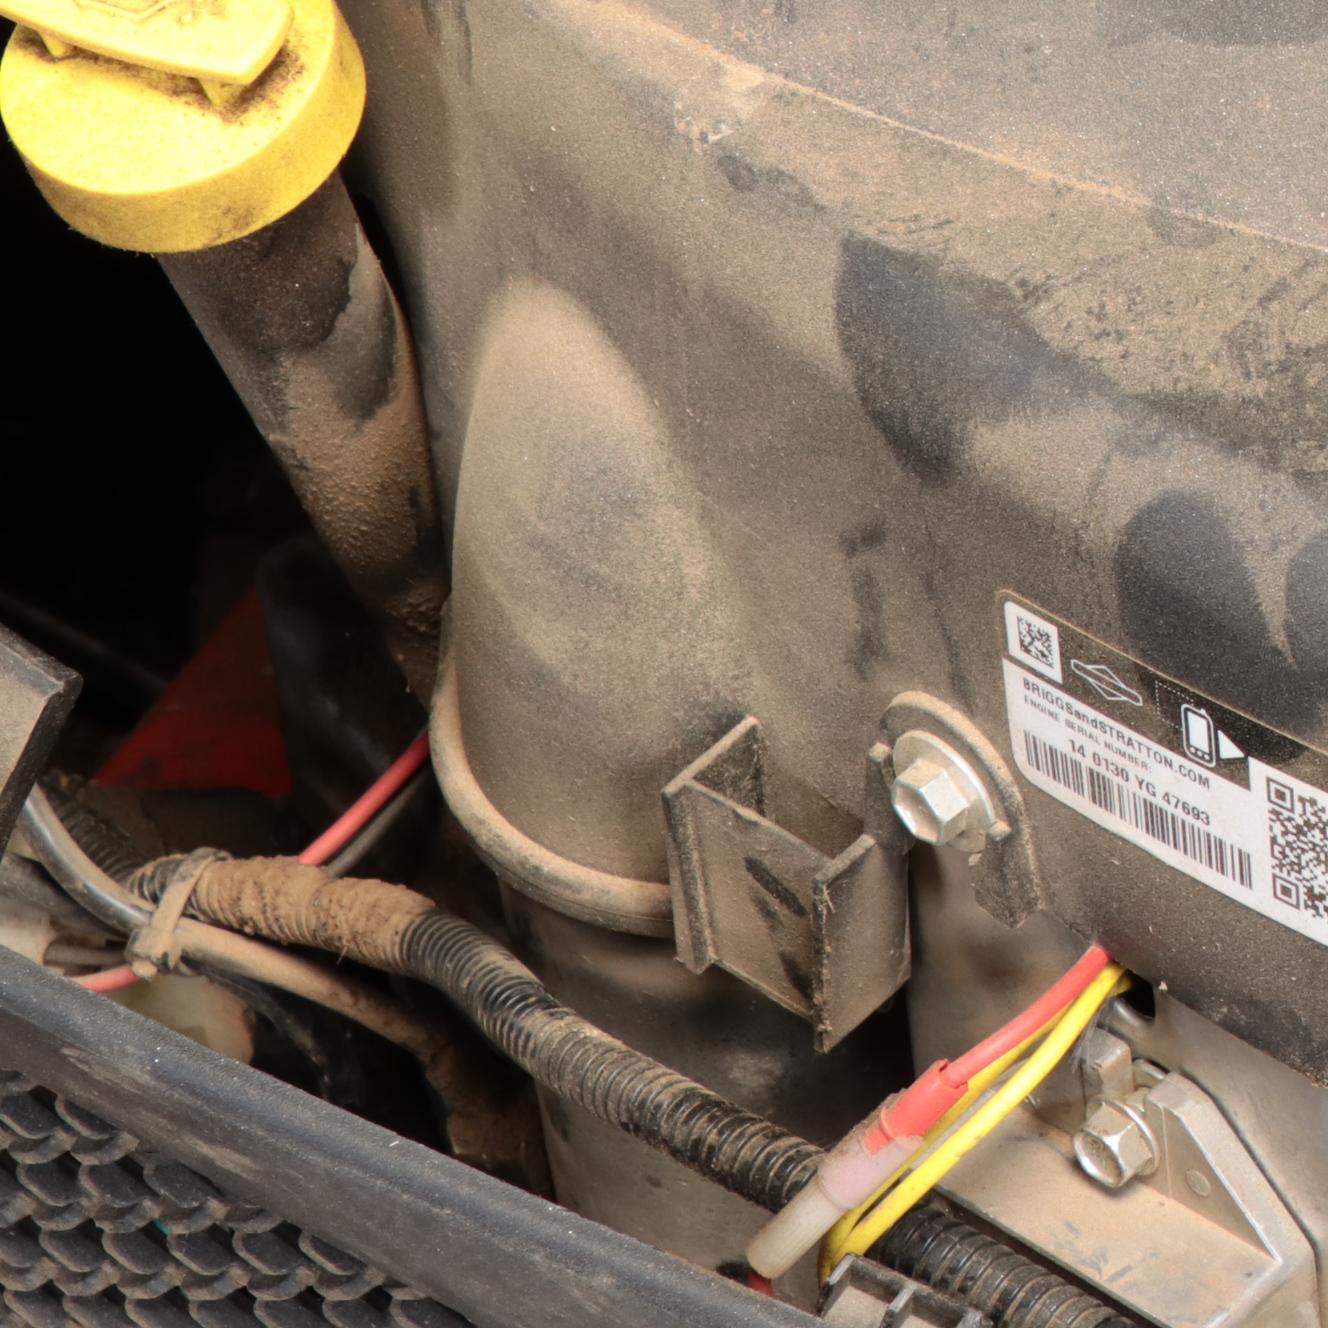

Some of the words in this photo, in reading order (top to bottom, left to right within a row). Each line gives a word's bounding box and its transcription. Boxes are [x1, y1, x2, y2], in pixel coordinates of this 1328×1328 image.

[1022, 676, 1211, 791] BRIGGSandSTRATTON.COM
[1023, 694, 1061, 723] ENGINE
[1064, 715, 1100, 746] SERIAL
[1068, 738, 1087, 758] 14
[1135, 776, 1157, 798] YG
[1161, 792, 1211, 826] 47693
